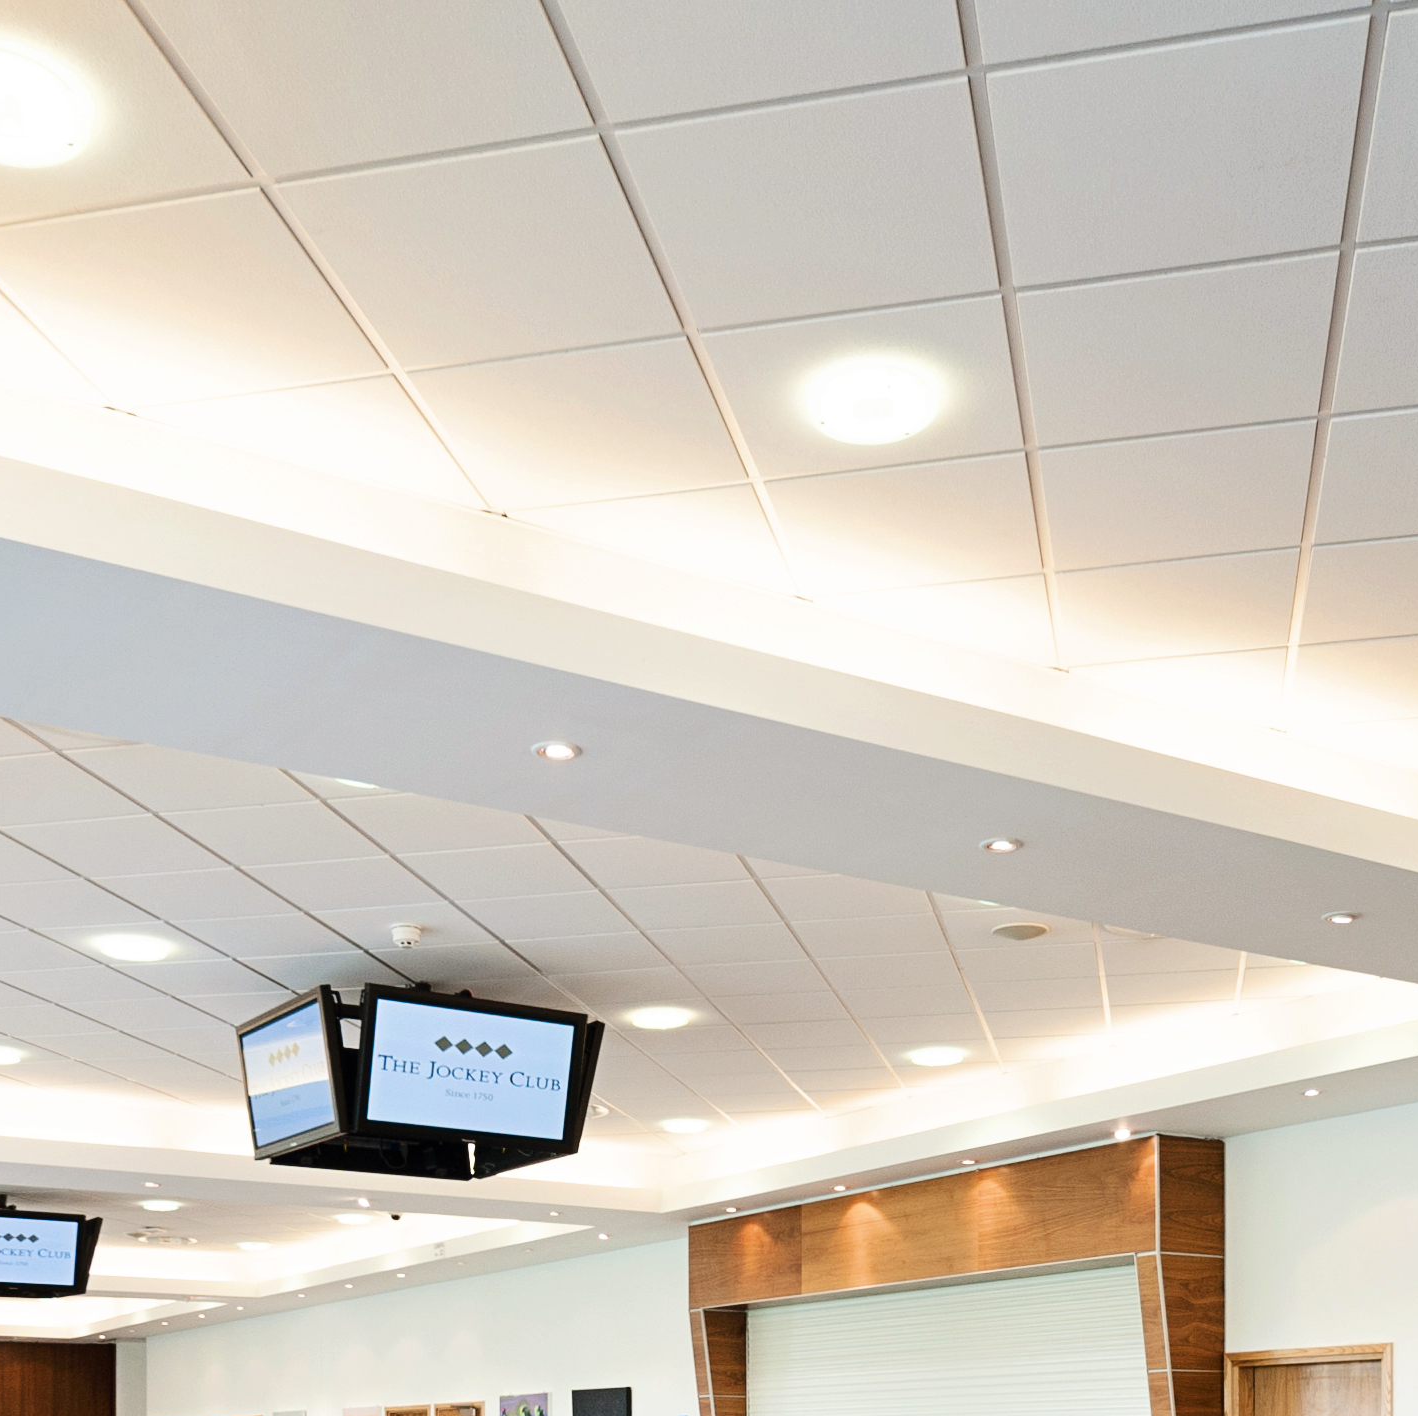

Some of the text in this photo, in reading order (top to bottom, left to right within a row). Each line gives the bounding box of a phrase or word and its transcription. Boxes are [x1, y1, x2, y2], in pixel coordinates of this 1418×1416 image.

[378, 1054, 561, 1092] THE JOCKEY CLUB
[444, 1087, 494, 1102] Since 1750
[37, 1248, 72, 1259] CLUB
